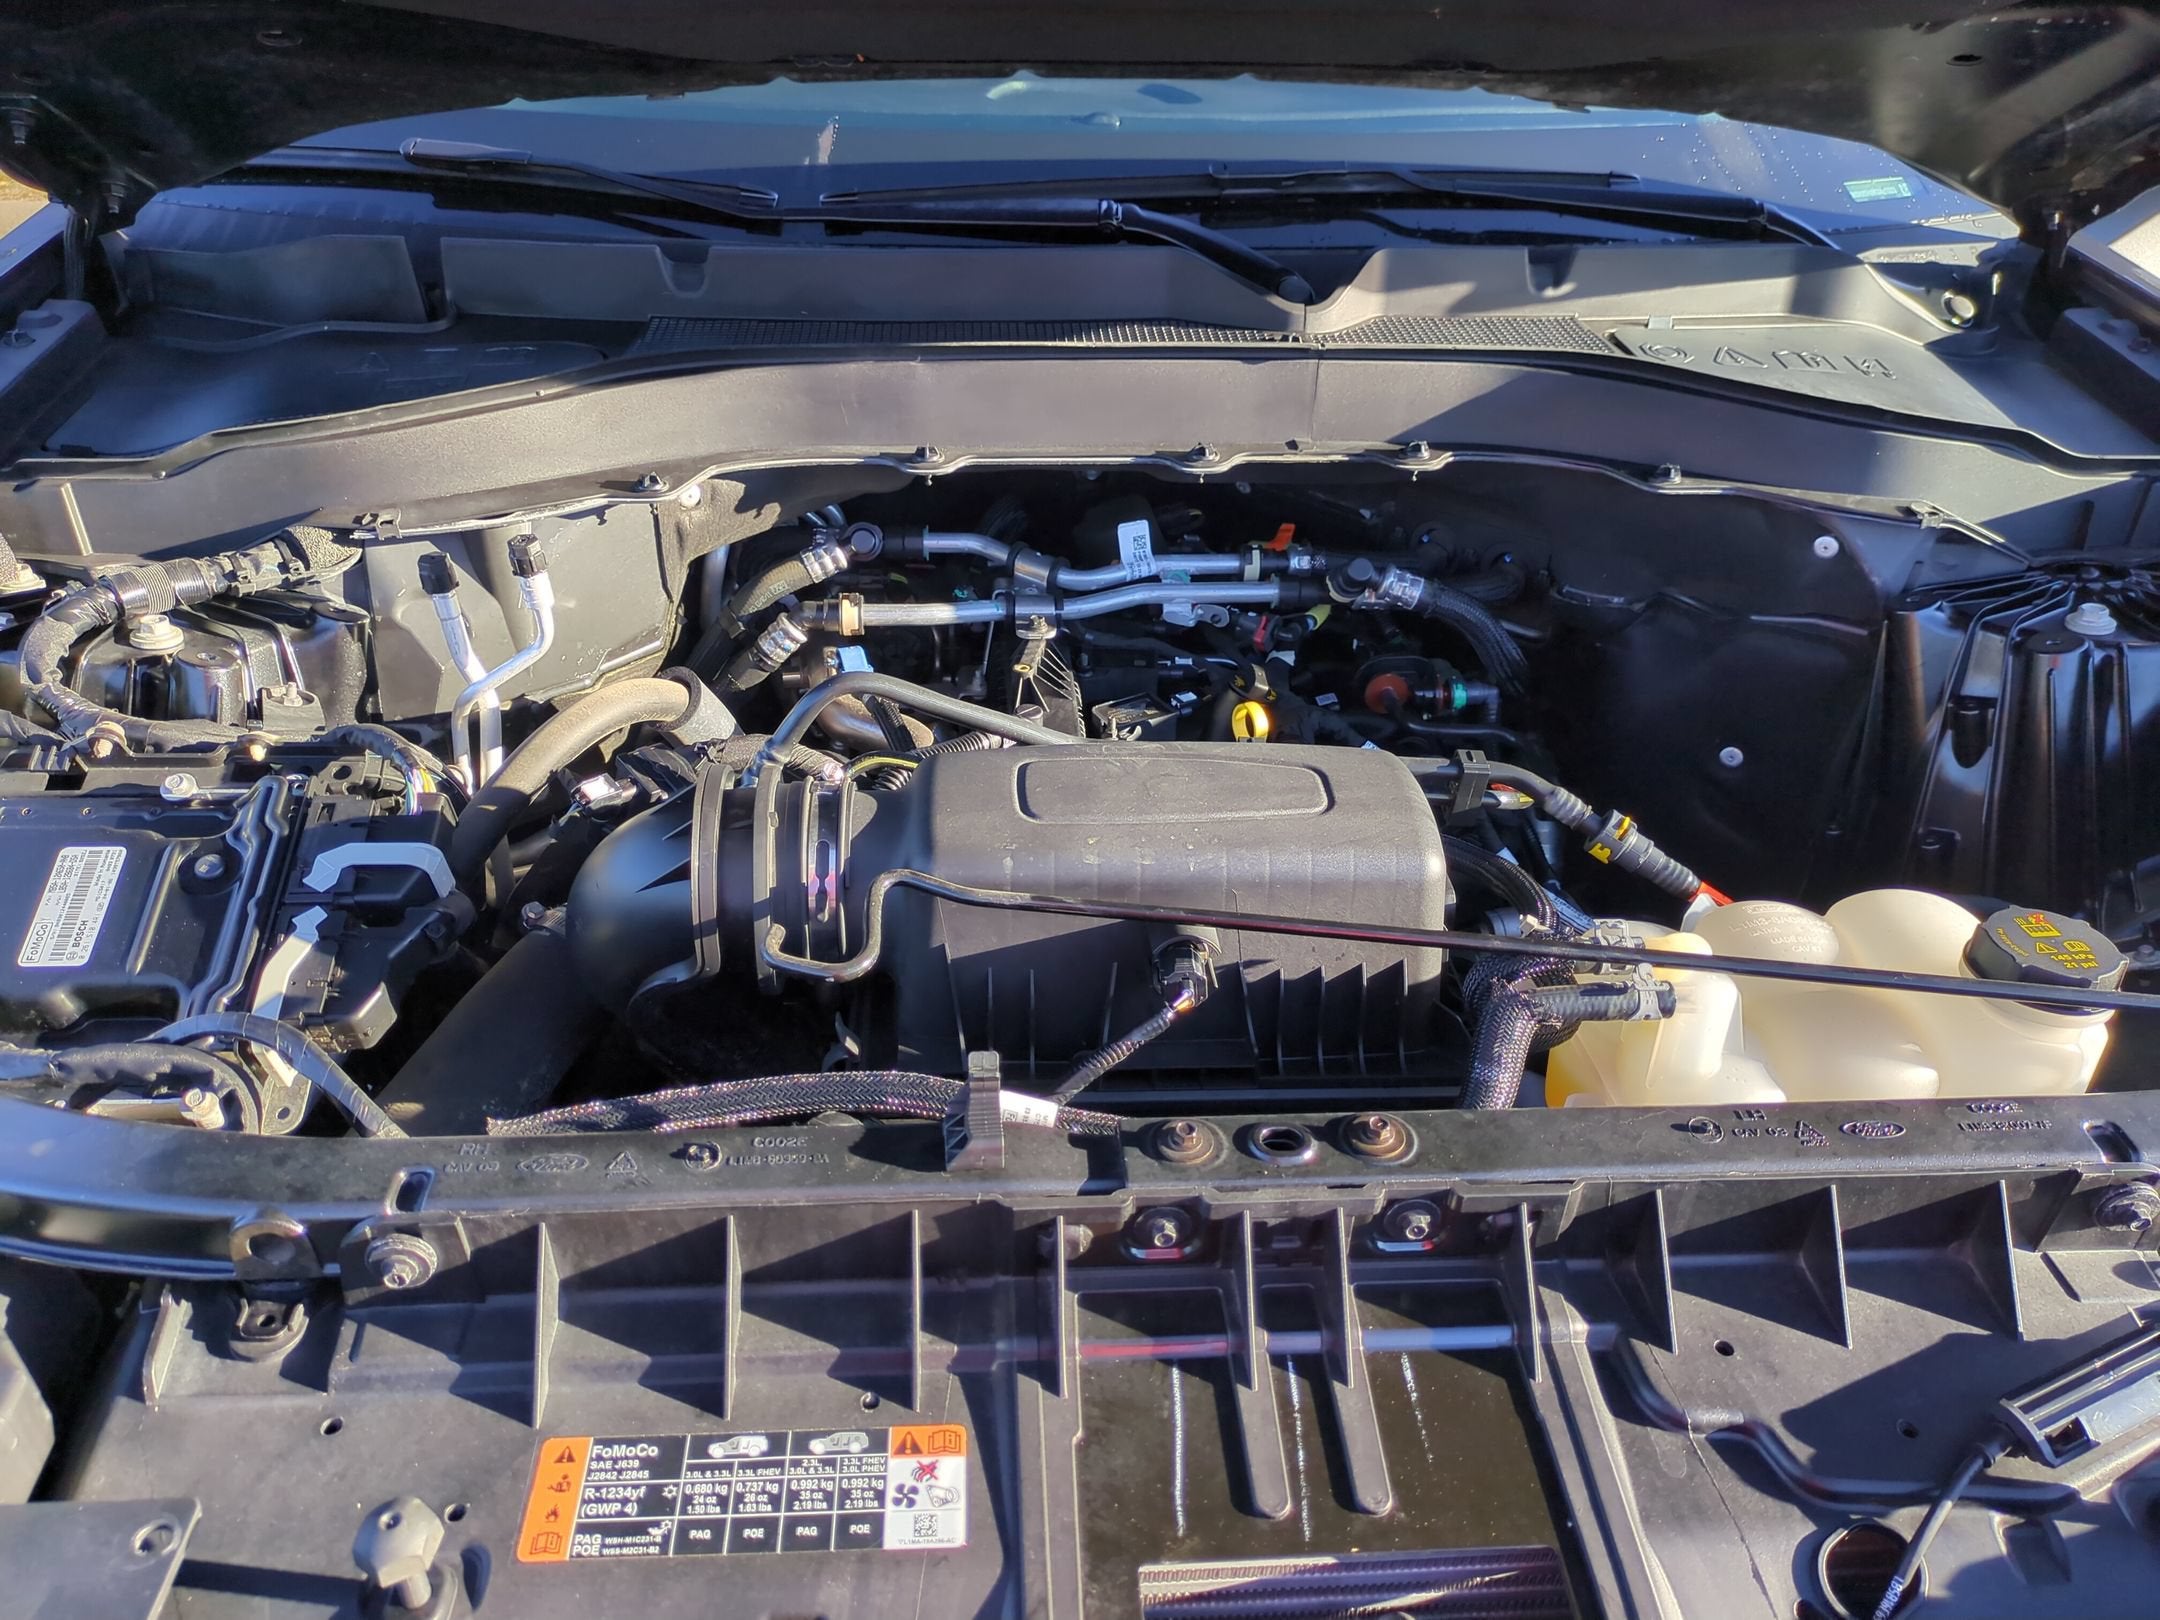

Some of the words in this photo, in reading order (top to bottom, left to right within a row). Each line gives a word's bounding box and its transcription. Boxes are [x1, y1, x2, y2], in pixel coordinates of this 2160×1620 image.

[72, 920, 88, 947] BOSCH
[26, 924, 48, 961] FoMoCo
[1733, 1109, 1767, 1121] LH
[458, 1143, 490, 1155] RH
[592, 1443, 659, 1459] FoMoCo
[590, 1460, 613, 1469] SAE
[614, 1459, 640, 1469] J639
[842, 1465, 860, 1473] 3.0L
[861, 1464, 886, 1472] PHEV
[587, 1471, 617, 1480] J2842
[619, 1470, 650, 1479] J2845
[686, 1470, 703, 1478] 3.0L
[713, 1469, 732, 1478] 3.3L
[737, 1469, 755, 1477] 3.3L
[756, 1468, 781, 1476] FHEV
[789, 1467, 807, 1475] 3.0L
[817, 1466, 834, 1474] 3.3L
[685, 1483, 713, 1495] 0.680
[714, 1483, 728, 1496] kg
[736, 1482, 764, 1493] 0.737
[766, 1481, 779, 1494] kg
[791, 1479, 818, 1490] 0.992
[820, 1479, 834, 1491] kg
[841, 1478, 869, 1489] 0.992
[871, 1478, 884, 1491] kg
[584, 1485, 647, 1500] R-1234yf
[799, 1491, 811, 1499] 35
[850, 1489, 862, 1498] 35
[863, 1490, 875, 1498] oz
[692, 1495, 704, 1504] 24
[705, 1496, 717, 1504] oz
[757, 1494, 768, 1502] oz
[686, 1505, 705, 1514] 1.50
[706, 1504, 721, 1513] lbs
[758, 1503, 772, 1512] lbs
[792, 1501, 812, 1510] 2.19
[813, 1501, 828, 1510] lbs
[844, 1499, 864, 1509] 2.19
[865, 1499, 879, 1508] lbs
[581, 1503, 622, 1517] (GWP
[624, 1502, 638, 1516] 4)
[689, 1529, 711, 1539] PAG
[743, 1528, 765, 1539] POE
[795, 1526, 818, 1536] PAG
[849, 1524, 871, 1534] POE
[575, 1534, 602, 1545] PAG
[572, 1544, 601, 1556] POE
